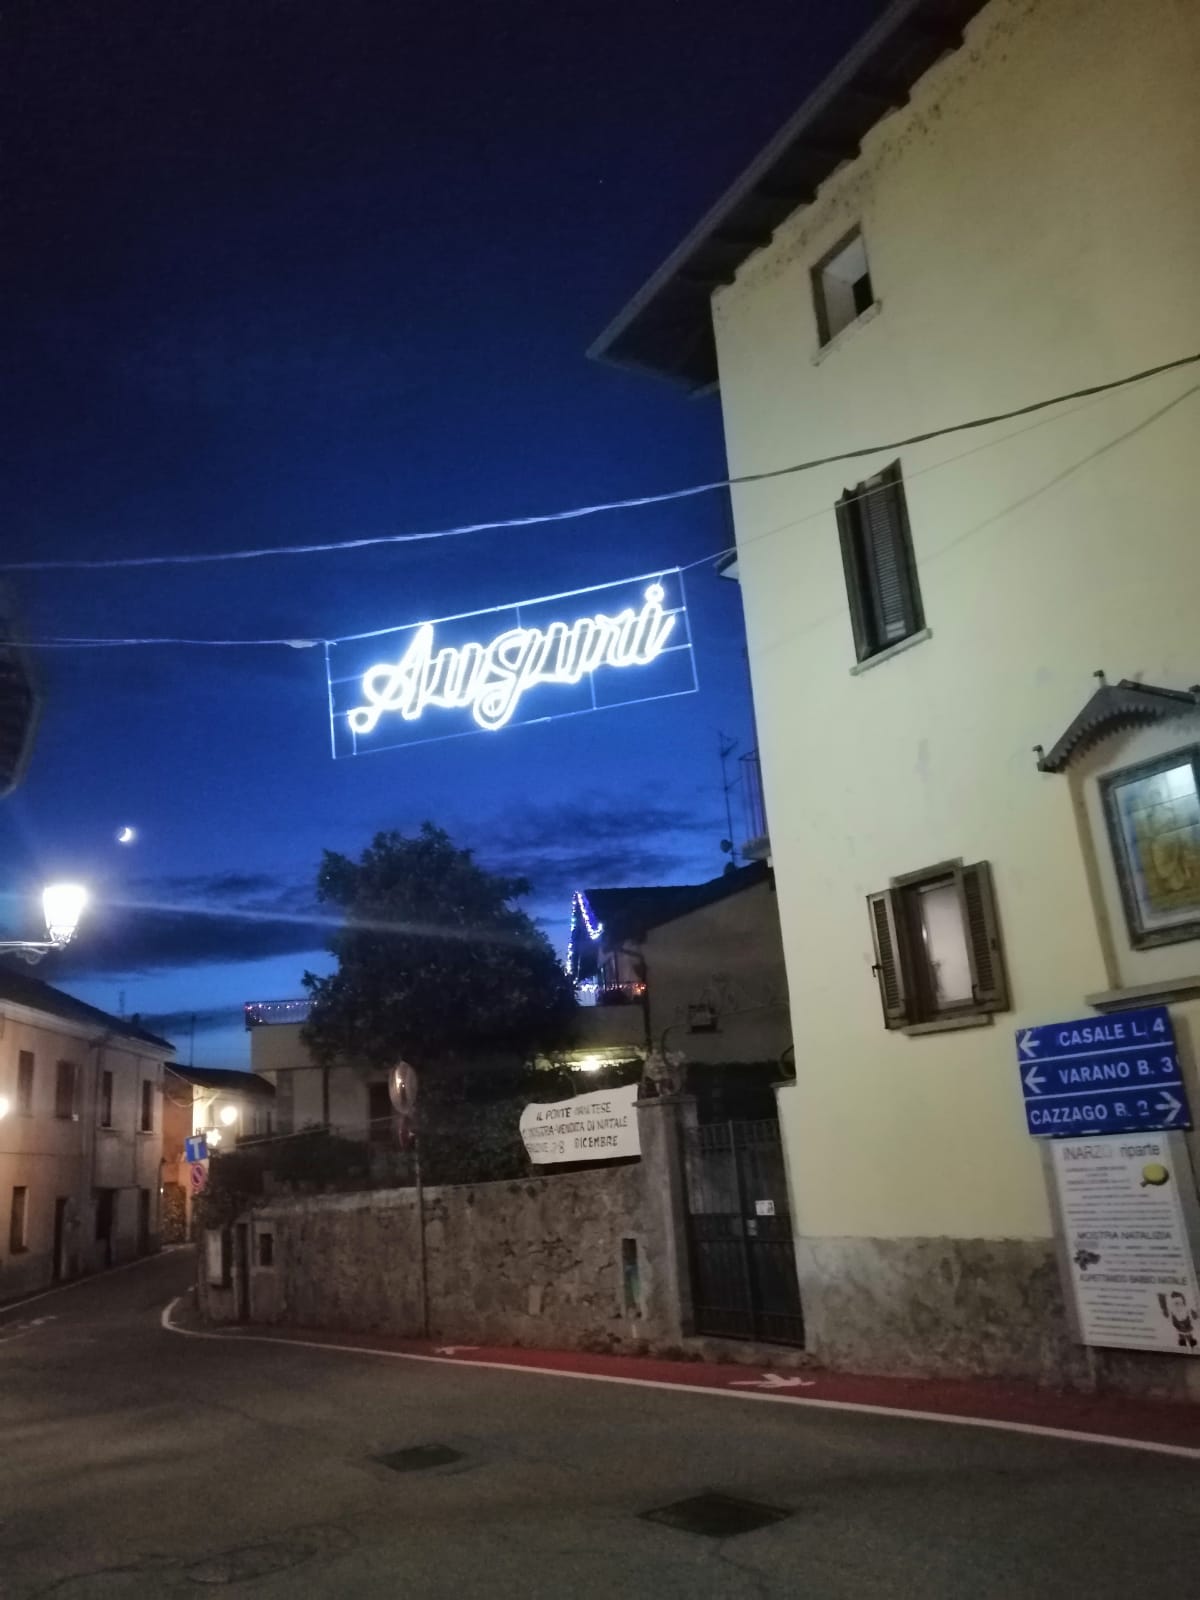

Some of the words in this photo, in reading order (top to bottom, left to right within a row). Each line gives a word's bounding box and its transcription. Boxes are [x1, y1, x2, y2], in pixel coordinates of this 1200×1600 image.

[347, 583, 675, 731] Auguri
[1059, 1023, 1125, 1046] CASALE
[1153, 1017, 1165, 1033] 4
[1058, 1062, 1130, 1084] VARANO
[1137, 1060, 1155, 1076] B.
[1161, 1057, 1174, 1073] 3
[535, 1111, 544, 1121] IL
[545, 1107, 571, 1121] PONTE
[587, 1121, 595, 1132] DI
[597, 1116, 628, 1131] NATALE
[1030, 1103, 1108, 1125] CAZZAGO
[574, 1135, 618, 1149] DICEMBRE
